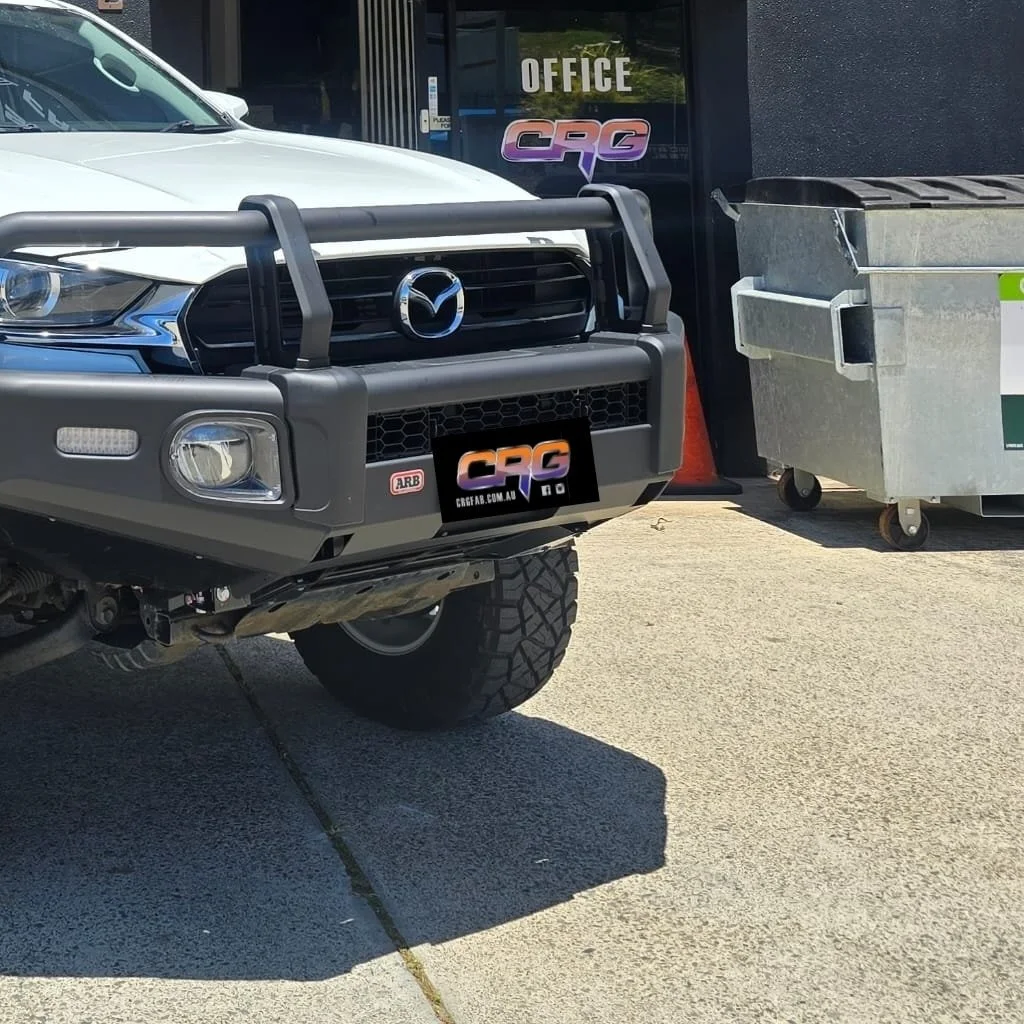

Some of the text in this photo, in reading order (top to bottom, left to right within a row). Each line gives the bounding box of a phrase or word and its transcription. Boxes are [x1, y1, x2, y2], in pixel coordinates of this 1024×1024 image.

[521, 57, 632, 93] OFFICE
[501, 118, 651, 183] CRG
[396, 475, 421, 490] ARB
